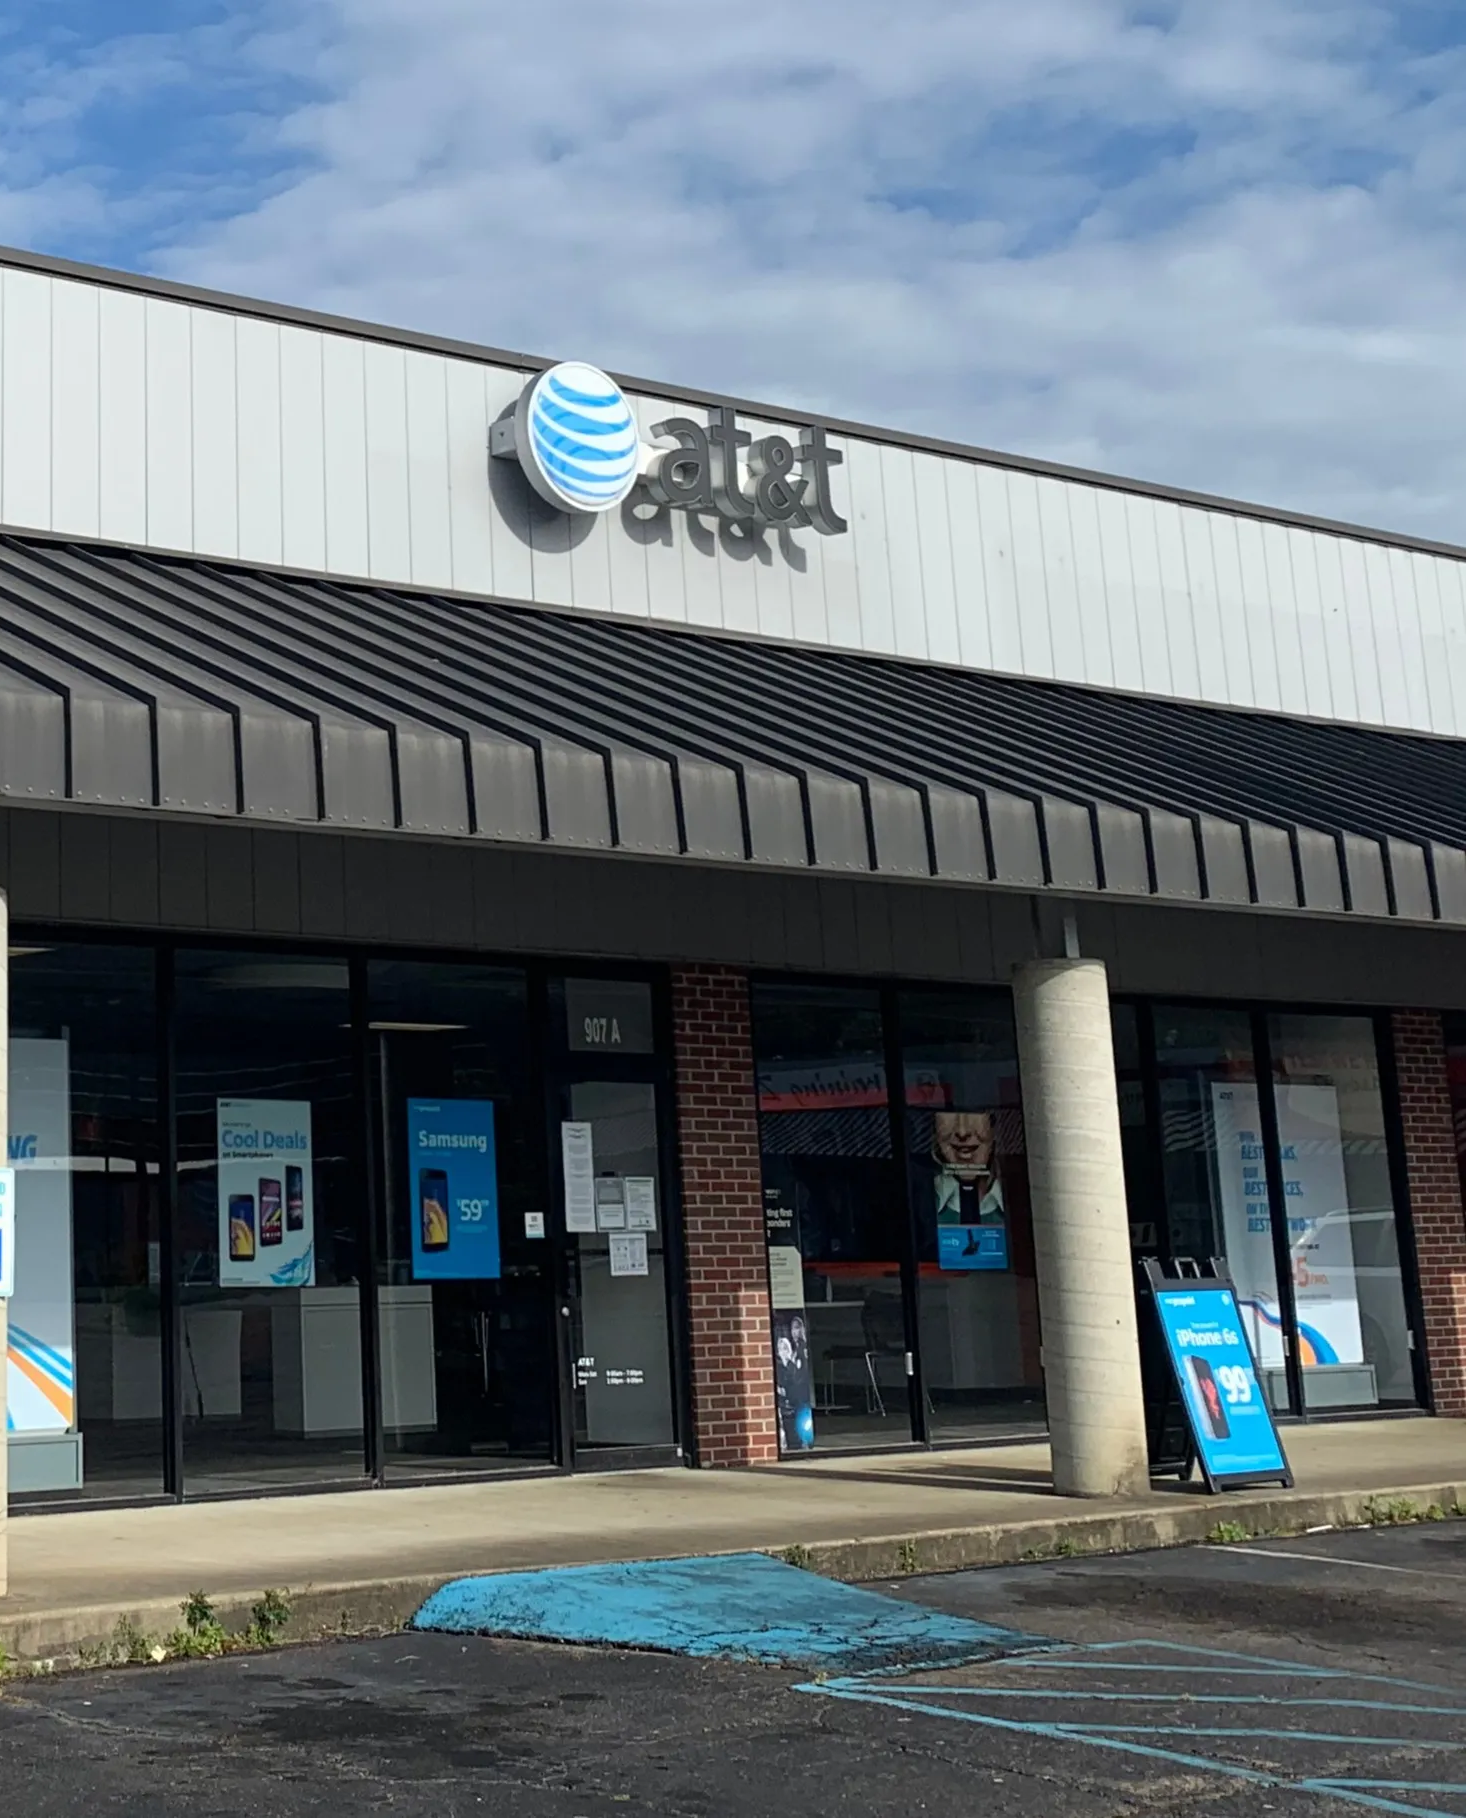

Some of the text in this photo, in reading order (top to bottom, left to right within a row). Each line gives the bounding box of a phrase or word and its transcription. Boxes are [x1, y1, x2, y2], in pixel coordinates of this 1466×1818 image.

[647, 408, 848, 535] at&t
[585, 1018, 621, 1044] 907 A
[223, 1129, 308, 1150] Cool Deals
[419, 1130, 487, 1153] Samsung
[1176, 1328, 1239, 1348] iPhone 6s
[578, 1357, 595, 1367] AT&T
